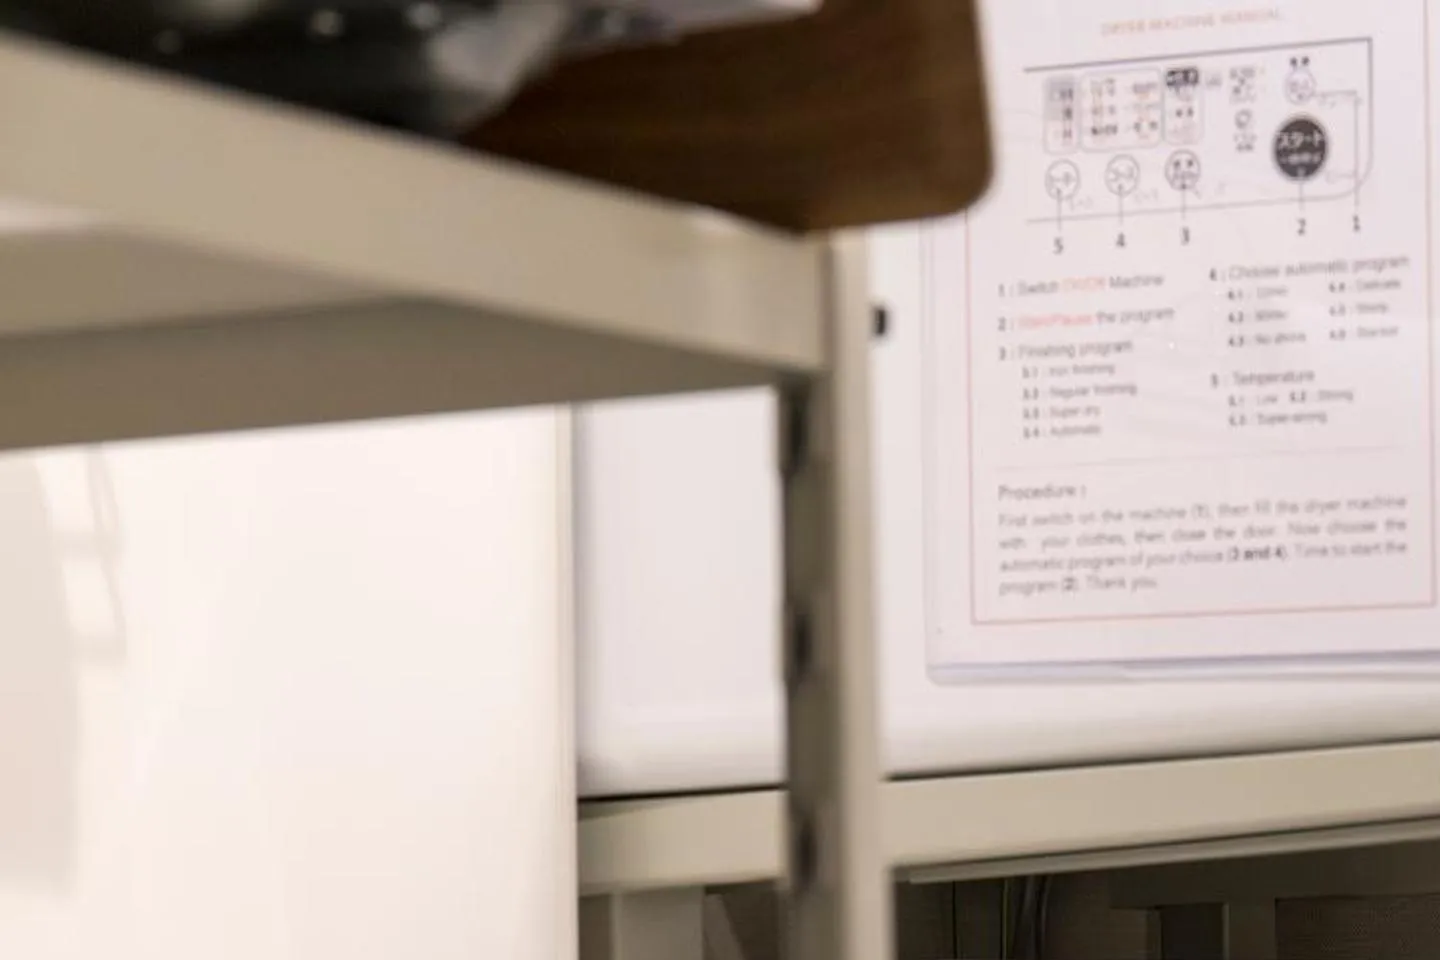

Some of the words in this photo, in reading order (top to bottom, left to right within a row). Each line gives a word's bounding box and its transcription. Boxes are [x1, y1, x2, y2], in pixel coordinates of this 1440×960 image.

[1053, 237, 1064, 255] 5
[1115, 231, 1127, 249] 4
[1180, 226, 1191, 246] 3
[1296, 217, 1307, 236] 2
[1352, 213, 1361, 232] 1
[1096, 309, 1117, 325] the
[1120, 307, 1175, 325] program
[1233, 370, 1315, 387] Temperature
[998, 484, 1077, 502] Procedure
[1129, 506, 1188, 522] machine
[1243, 545, 1270, 562] and
